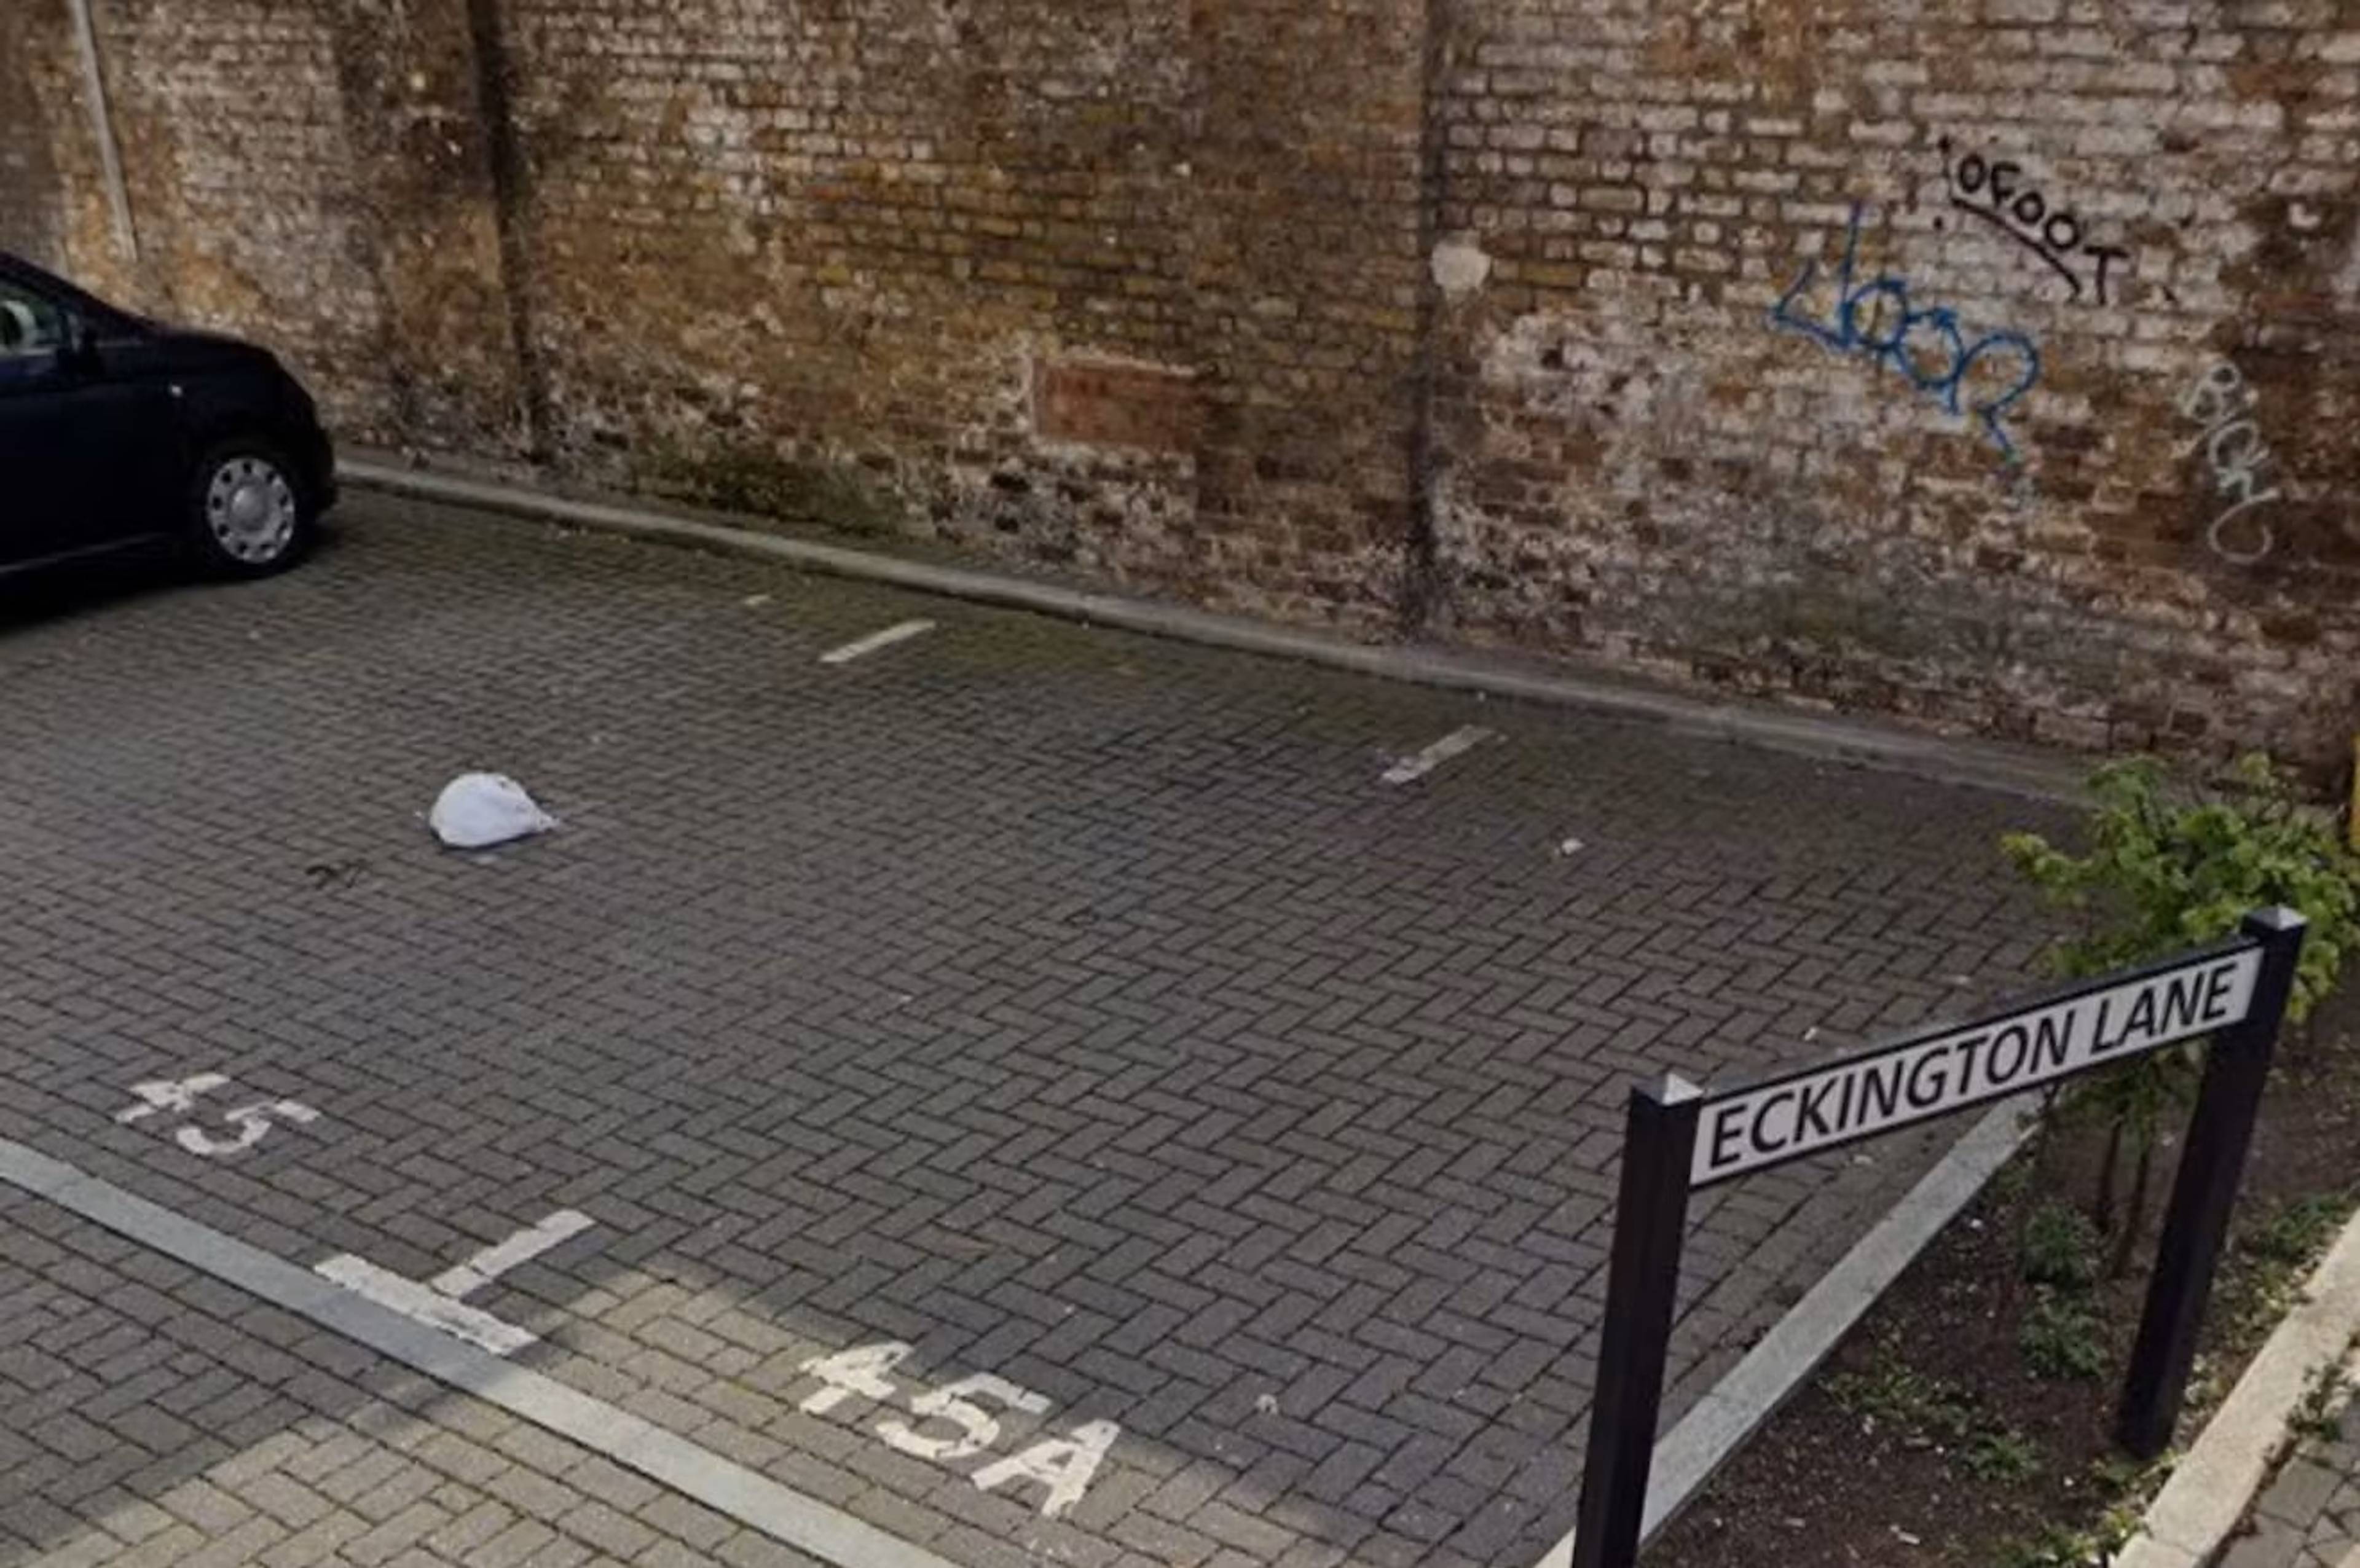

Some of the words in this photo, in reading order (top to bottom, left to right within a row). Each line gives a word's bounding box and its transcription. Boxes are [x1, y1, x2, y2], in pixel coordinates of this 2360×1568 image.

[116, 1072, 321, 1154] 45
[1709, 1013, 2075, 1169] ECKINGTON
[2091, 963, 2238, 1051] LANE
[799, 1342, 1121, 1516] 45A
